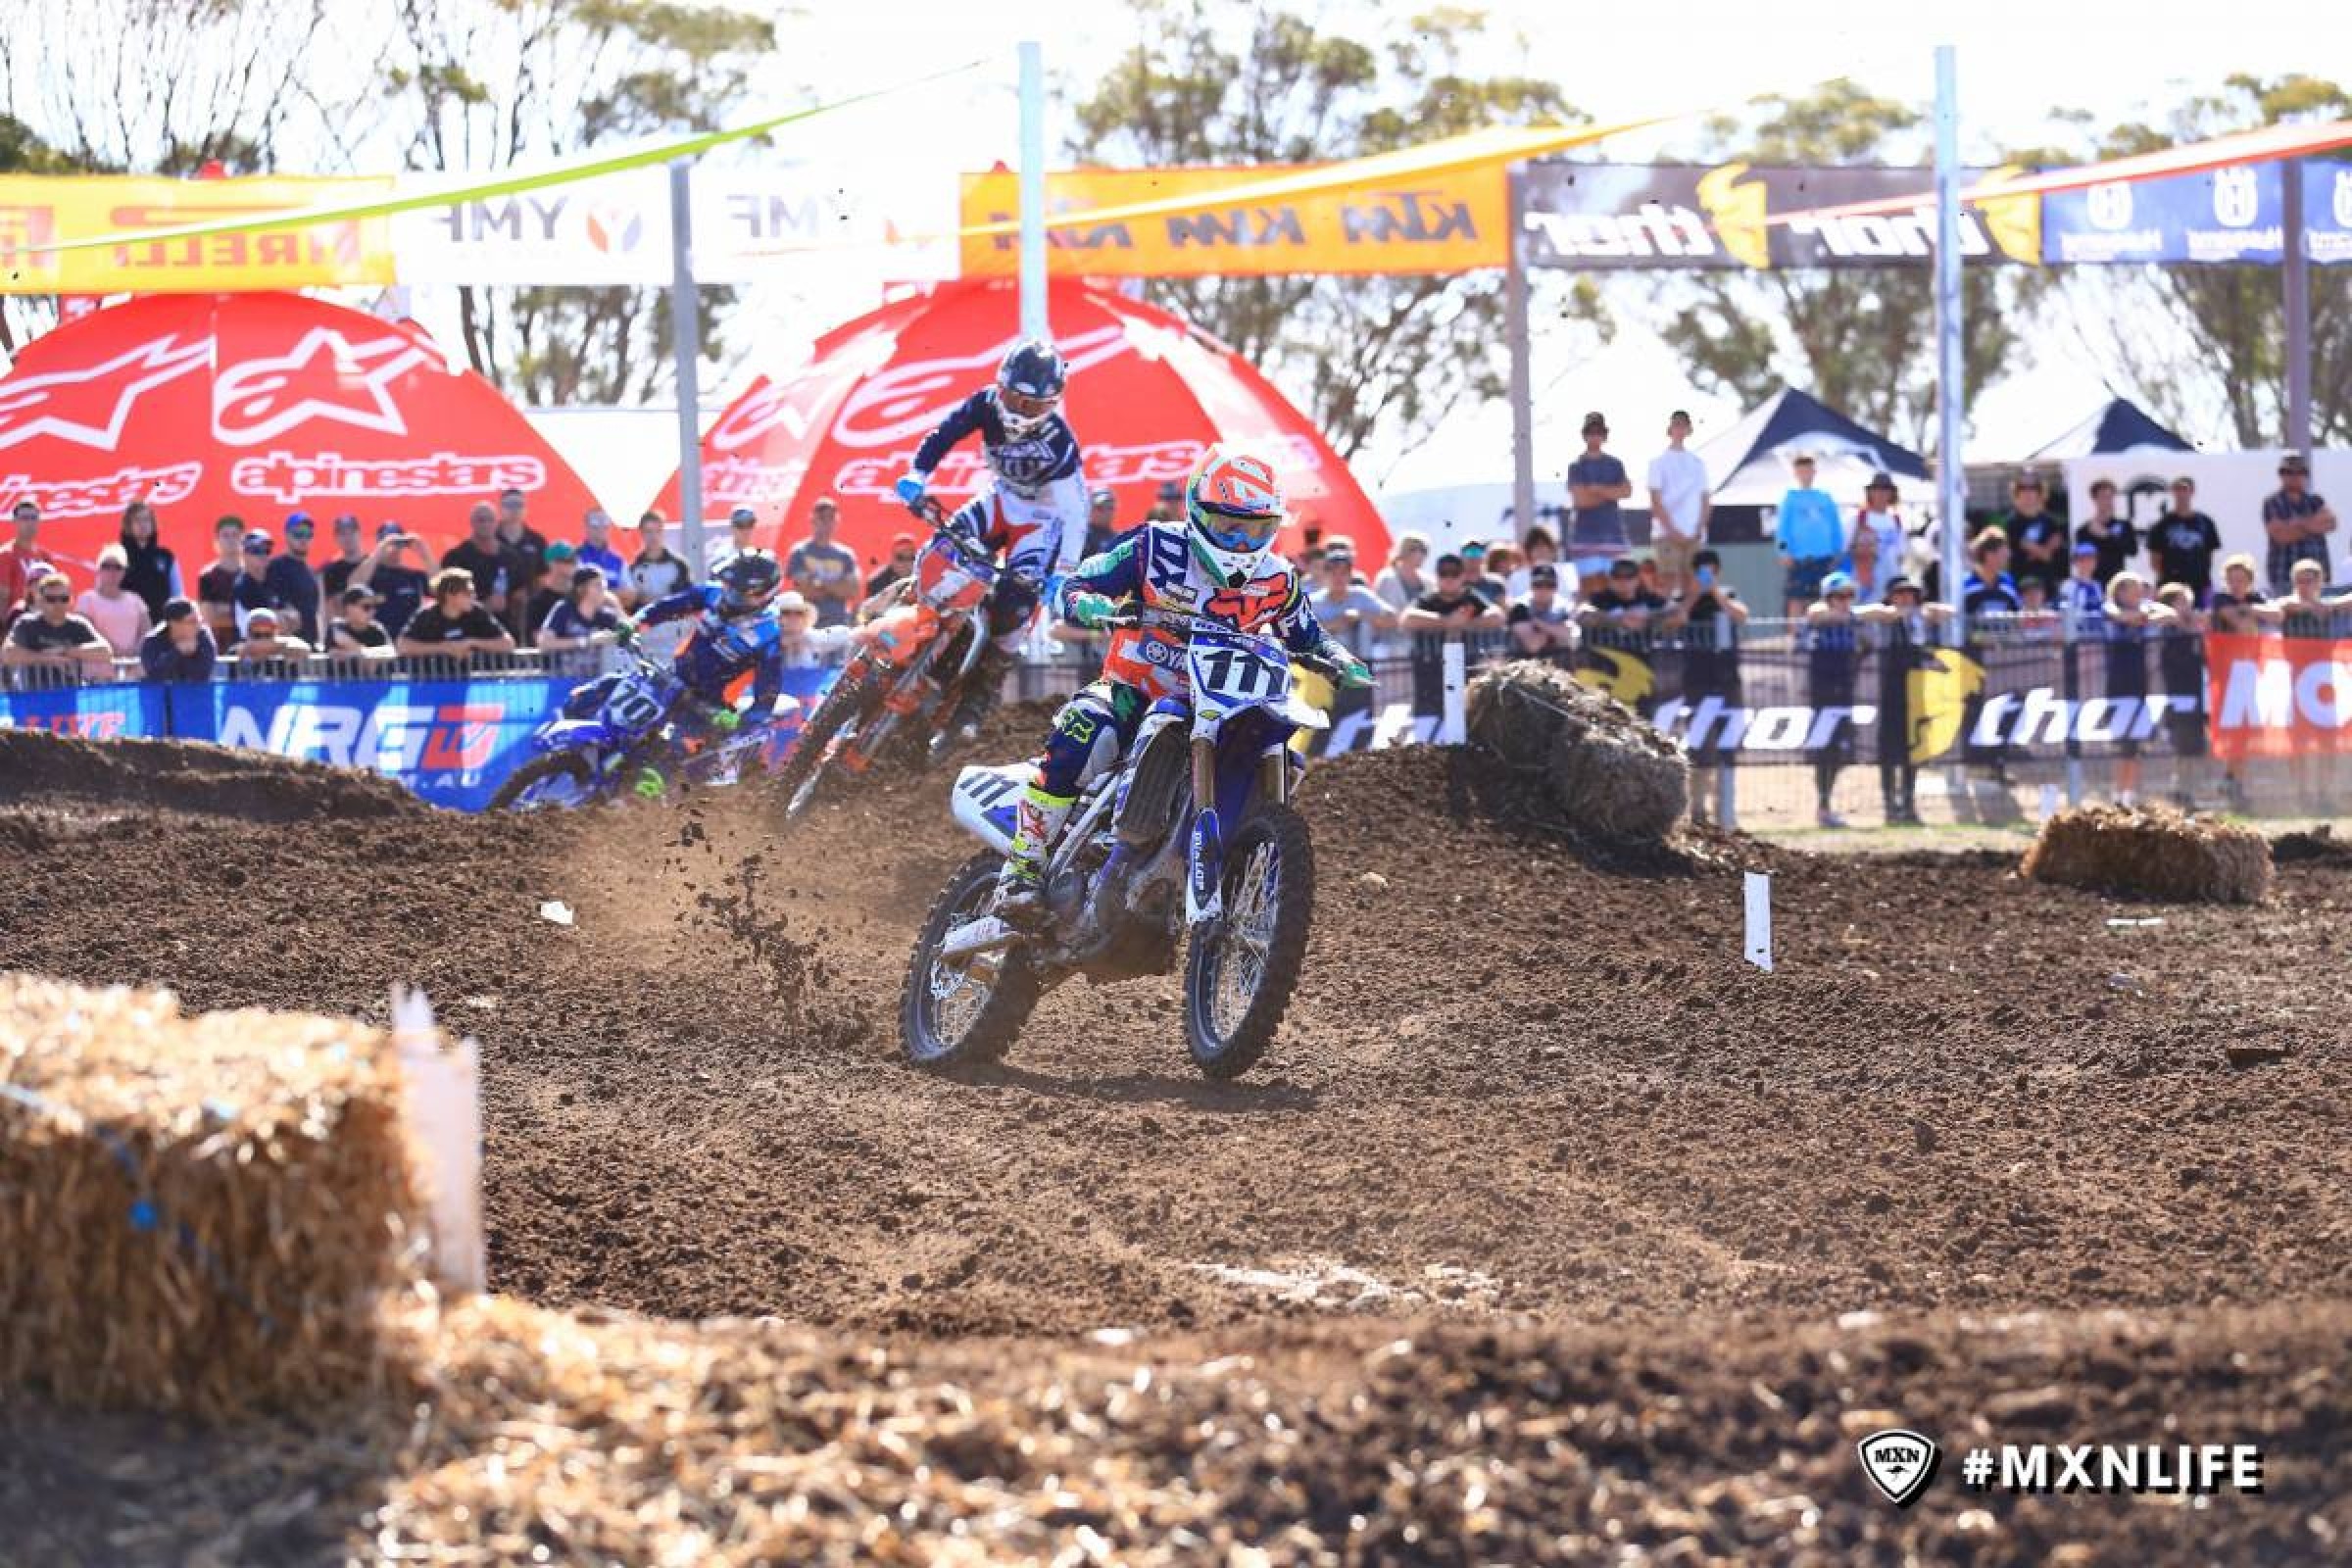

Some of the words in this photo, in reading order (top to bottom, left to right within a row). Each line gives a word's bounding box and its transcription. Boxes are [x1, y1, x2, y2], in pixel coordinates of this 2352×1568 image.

[231, 451, 546, 504] alpinestars
[1202, 649, 1287, 696] 111
[609, 684, 663, 726] 70
[1653, 695, 1878, 750] thor
[1969, 687, 2196, 747] thor
[958, 772, 1020, 808] 111
